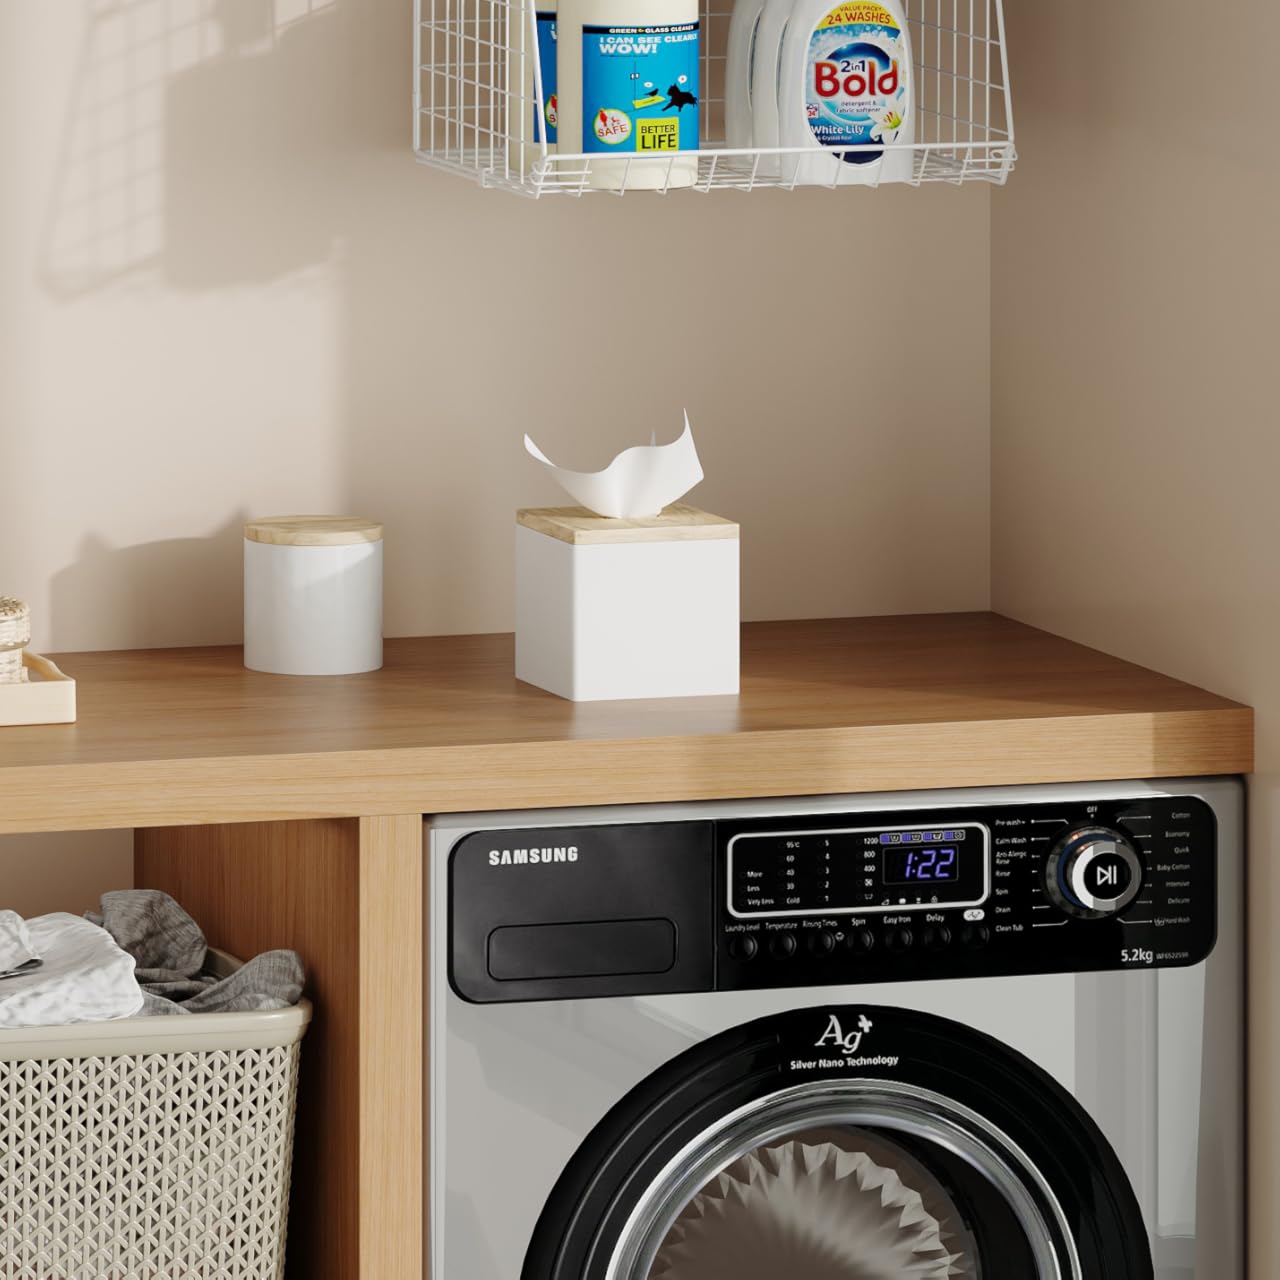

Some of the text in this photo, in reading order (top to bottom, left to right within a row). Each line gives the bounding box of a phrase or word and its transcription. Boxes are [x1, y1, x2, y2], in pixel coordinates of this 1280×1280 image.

[827, 12, 890, 24] 24 WASHES
[607, 36, 633, 44] CAN
[637, 36, 662, 44] SEE
[600, 43, 657, 54] WOW!
[815, 59, 898, 97] Bold
[598, 124, 628, 137] SAFE
[641, 124, 675, 134] BETTER
[811, 125, 864, 135] White Lily
[642, 133, 677, 149] LIFE
[489, 846, 578, 865] SAMSUNG
[905, 849, 954, 878] 1:22
[851, 918, 866, 926] Spin
[883, 916, 898, 924] Easy
[926, 914, 944, 922] Delay
[1121, 948, 1153, 964] 5.2kg
[790, 1055, 899, 1070] Silver Nano Technology
